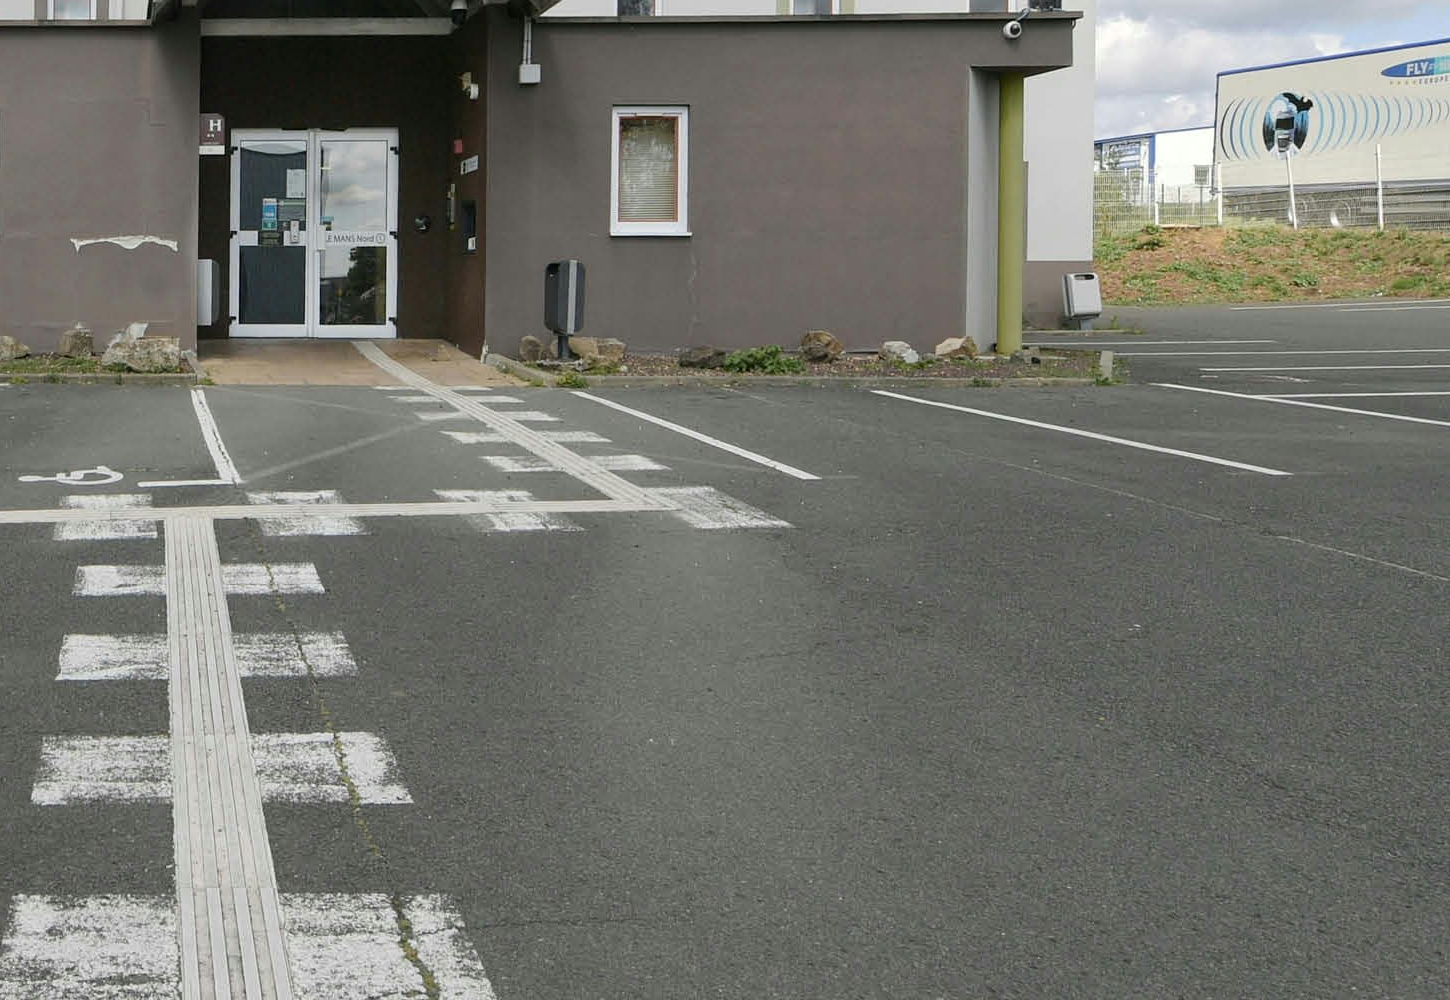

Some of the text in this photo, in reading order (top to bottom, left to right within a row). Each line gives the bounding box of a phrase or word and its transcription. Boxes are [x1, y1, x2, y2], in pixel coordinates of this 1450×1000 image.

[1406, 61, 1430, 76] FLY
[209, 119, 221, 131] H
[333, 234, 355, 242] MANS
[357, 233, 374, 242] Nord
